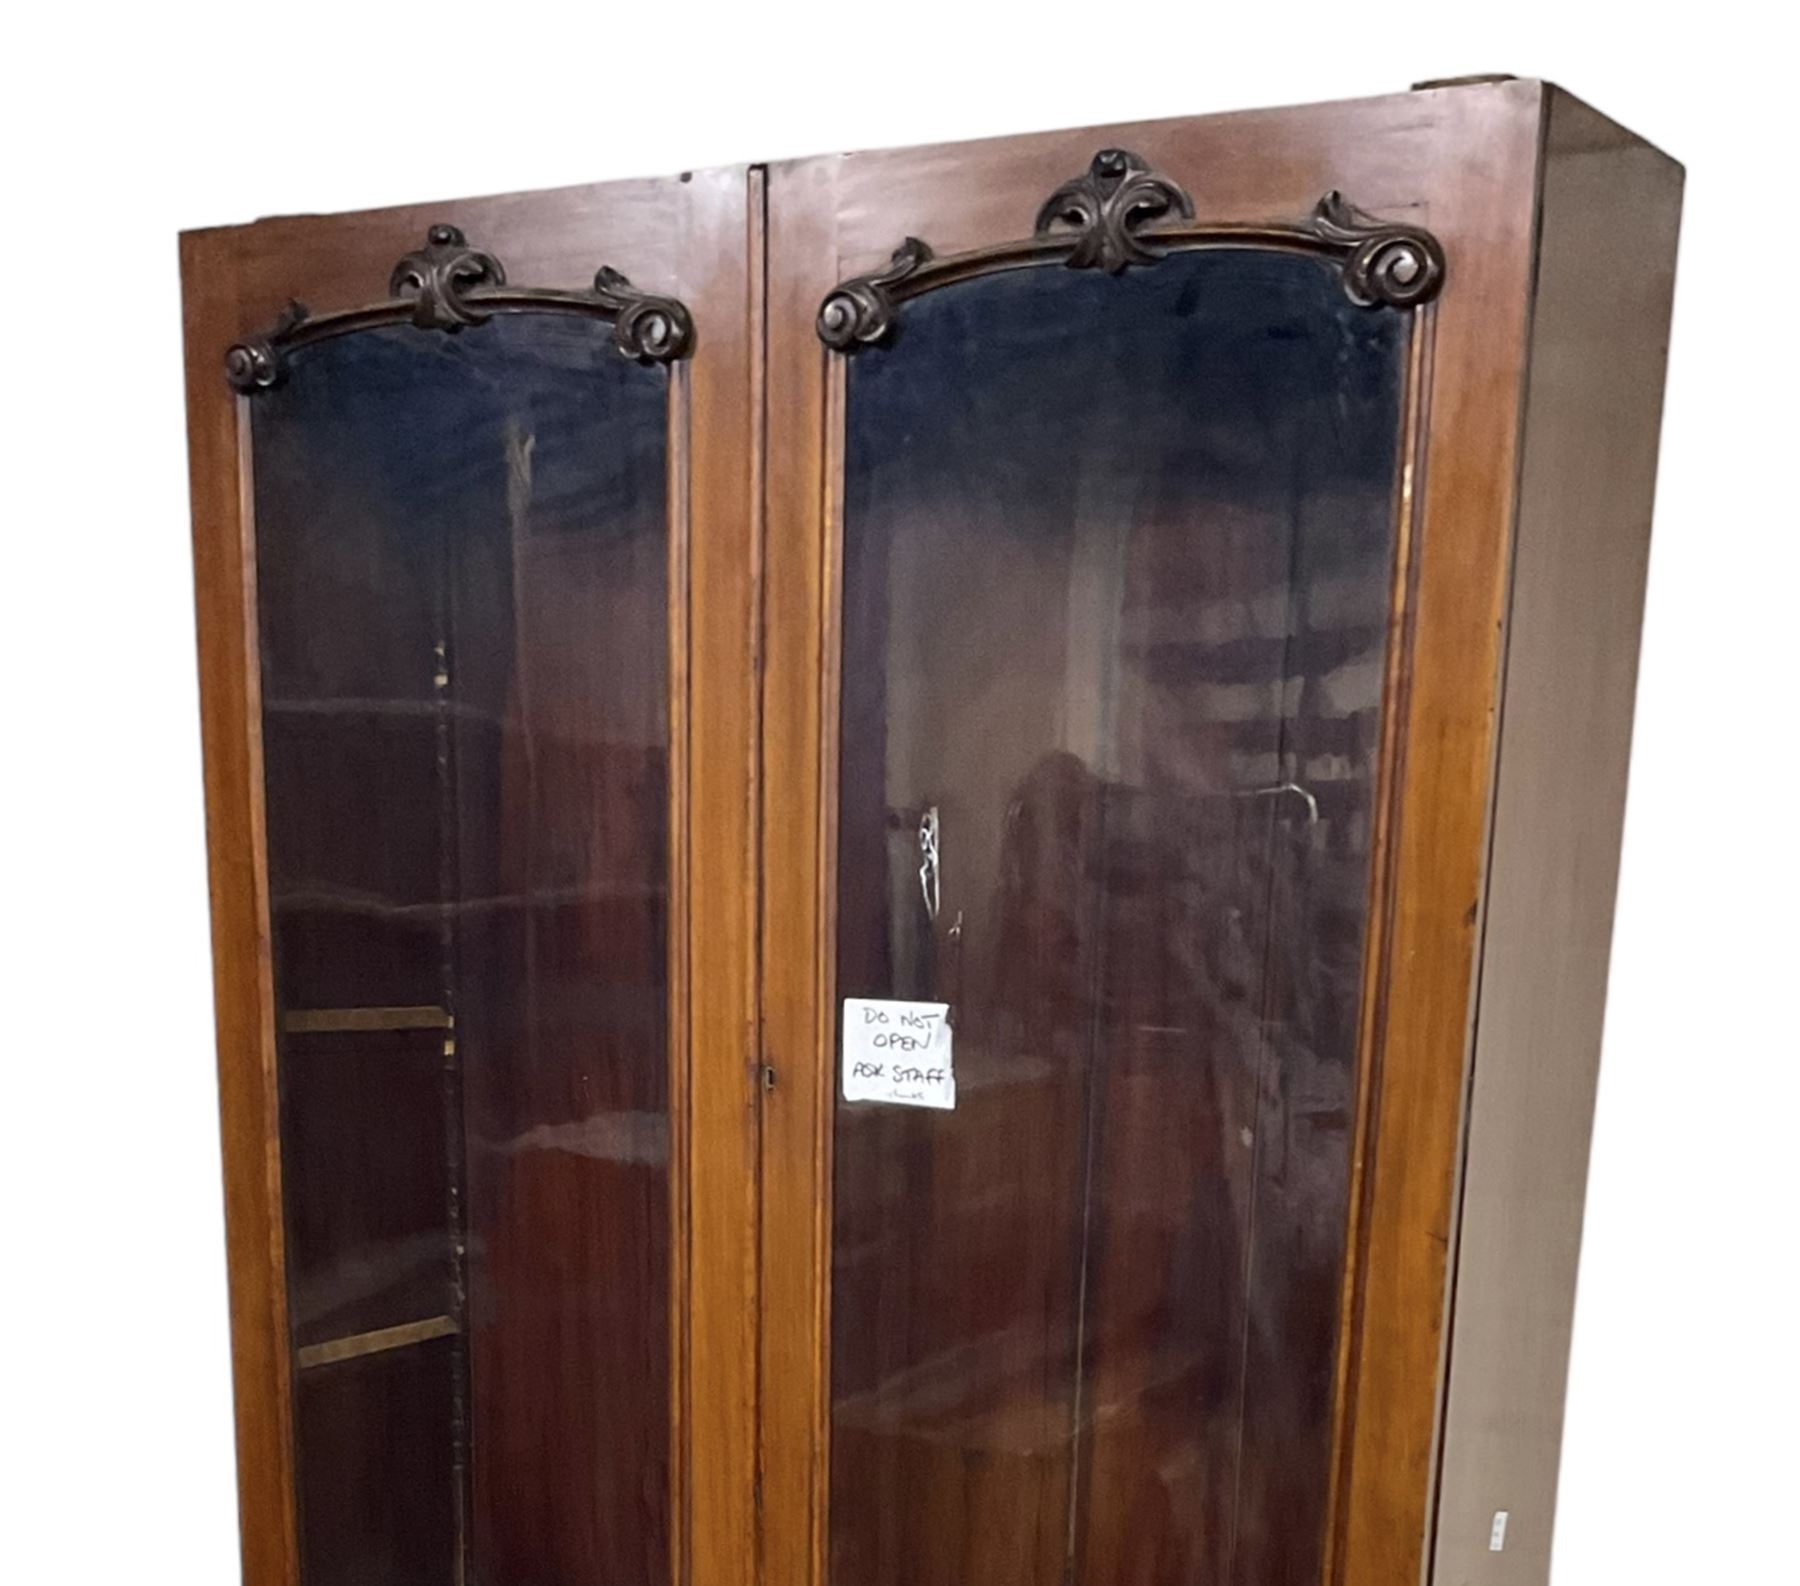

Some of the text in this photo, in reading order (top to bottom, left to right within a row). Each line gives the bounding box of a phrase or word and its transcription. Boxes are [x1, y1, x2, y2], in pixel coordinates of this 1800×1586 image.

[862, 1007, 890, 1024] DO
[873, 1032, 932, 1051] OPEN
[852, 1062, 945, 1085] ASK STAFF
